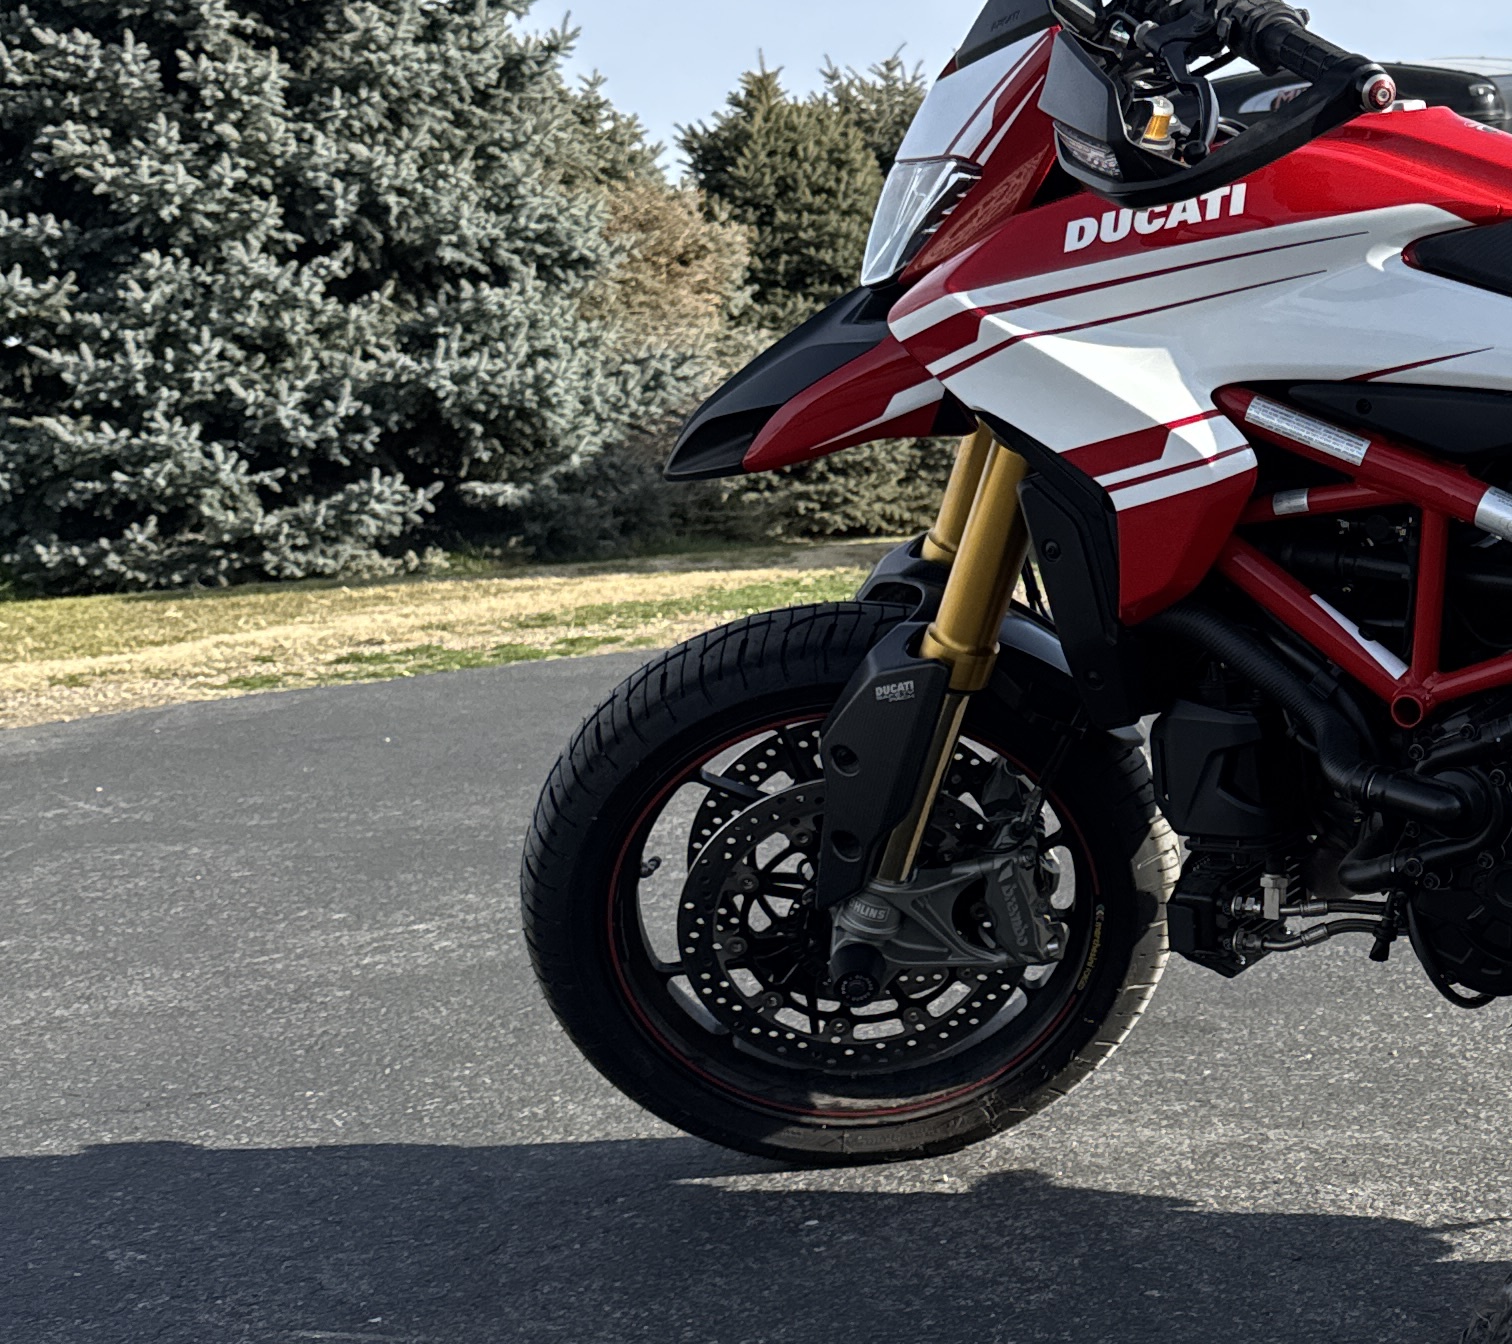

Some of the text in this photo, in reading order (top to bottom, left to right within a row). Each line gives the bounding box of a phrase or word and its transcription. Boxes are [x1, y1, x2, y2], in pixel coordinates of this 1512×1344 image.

[1063, 182, 1247, 253] DUCATI
[875, 680, 915, 696] DUCATI
[1001, 882, 1028, 947] brembo
